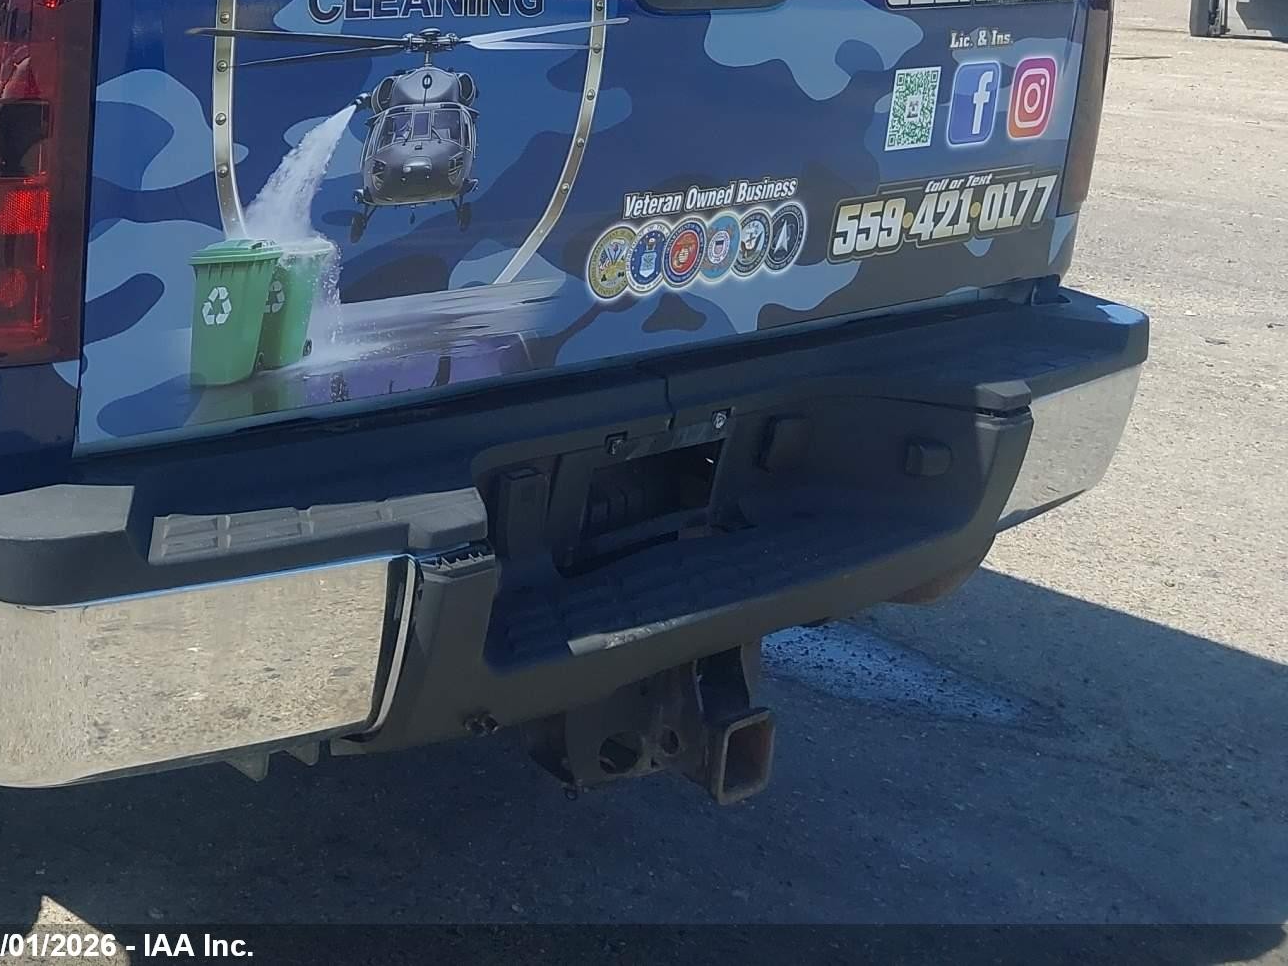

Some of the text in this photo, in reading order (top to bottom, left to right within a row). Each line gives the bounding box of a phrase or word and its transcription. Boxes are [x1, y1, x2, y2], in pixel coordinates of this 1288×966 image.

[977, 30, 987, 46] &
[925, 173, 993, 193] Call or Text
[624, 177, 798, 218] Veteran Owned Business
